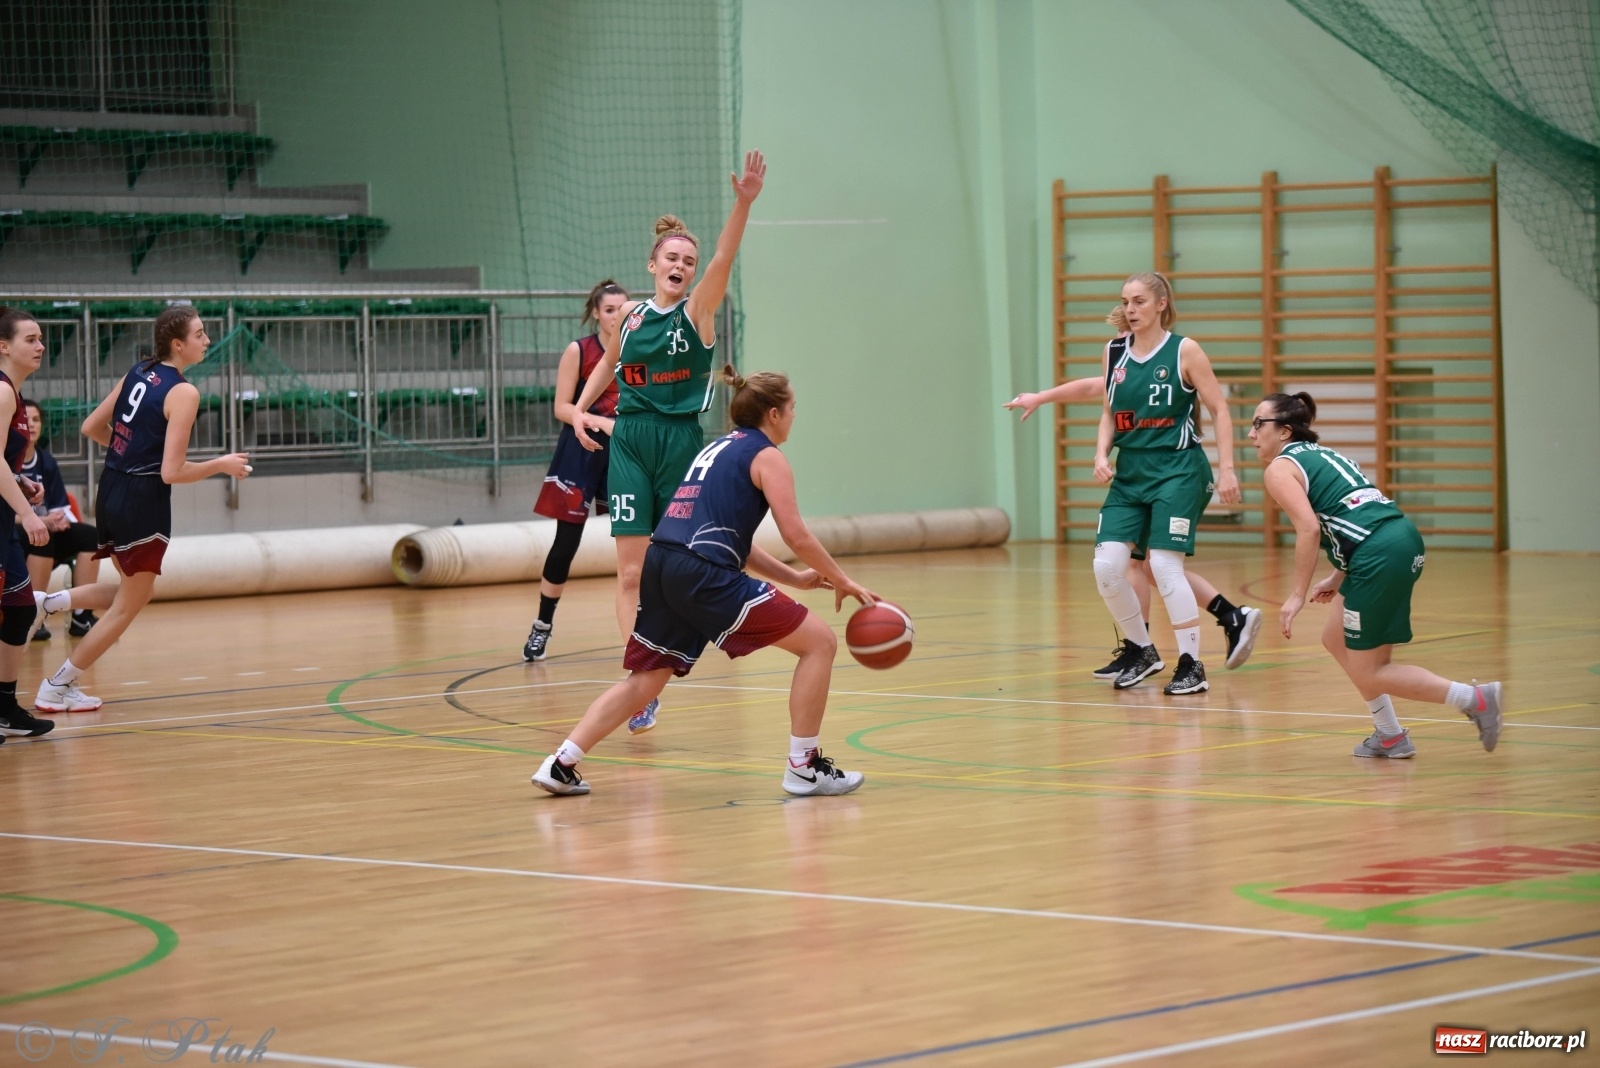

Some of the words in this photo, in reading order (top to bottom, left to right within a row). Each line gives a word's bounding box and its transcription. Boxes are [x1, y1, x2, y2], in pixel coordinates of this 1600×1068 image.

[666, 328, 690, 355] 35
[623, 367, 645, 384] K
[652, 369, 691, 383] KAMAN
[121, 381, 147, 423] 9
[1148, 383, 1173, 406] 27
[1115, 413, 1132, 430] K
[684, 440, 732, 482] 14
[610, 494, 636, 522] 35
